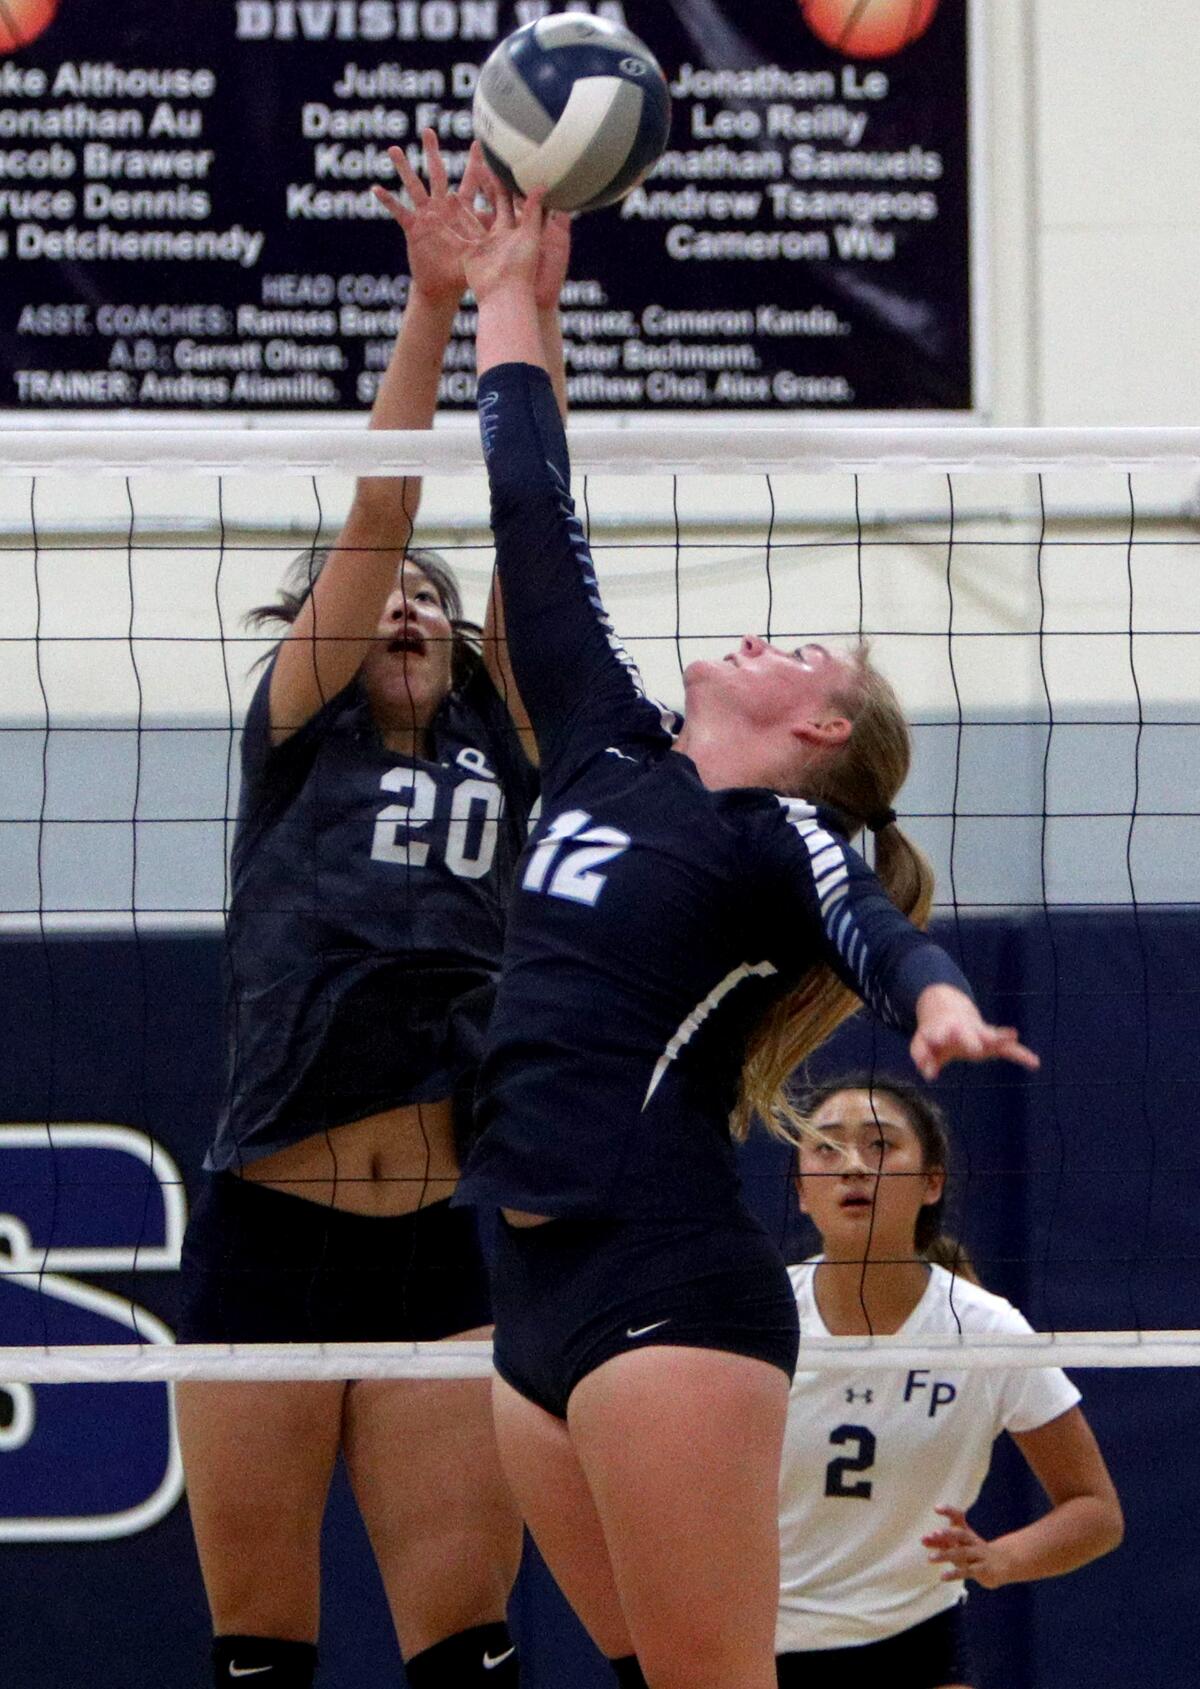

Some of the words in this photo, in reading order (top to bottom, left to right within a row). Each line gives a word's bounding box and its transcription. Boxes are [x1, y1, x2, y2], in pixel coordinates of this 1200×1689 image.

[235, 0, 498, 41] DIVISION
[0, 61, 48, 98] ke
[53, 61, 216, 98] Althouse
[333, 62, 444, 98] Julian
[669, 62, 835, 99] Jonathan
[842, 64, 889, 99] Le
[0, 103, 144, 138] onathan
[149, 101, 203, 138] Au
[301, 103, 409, 139] Dante
[691, 103, 761, 139] Leo
[766, 103, 868, 147] Reilly
[84, 142, 215, 179] Brawer
[650, 144, 784, 180] nathan
[790, 144, 943, 180] Samuels
[84, 183, 212, 220] Dennis
[621, 184, 762, 220] Andrew
[17, 222, 265, 268] Detchemendy
[665, 223, 830, 260] Cameron
[834, 223, 896, 260] Wu
[261, 274, 336, 305] HEAD
[370, 767, 503, 880] 20
[521, 808, 631, 907] 12
[904, 1369, 957, 1418] FP
[825, 1423, 876, 1500] 2
